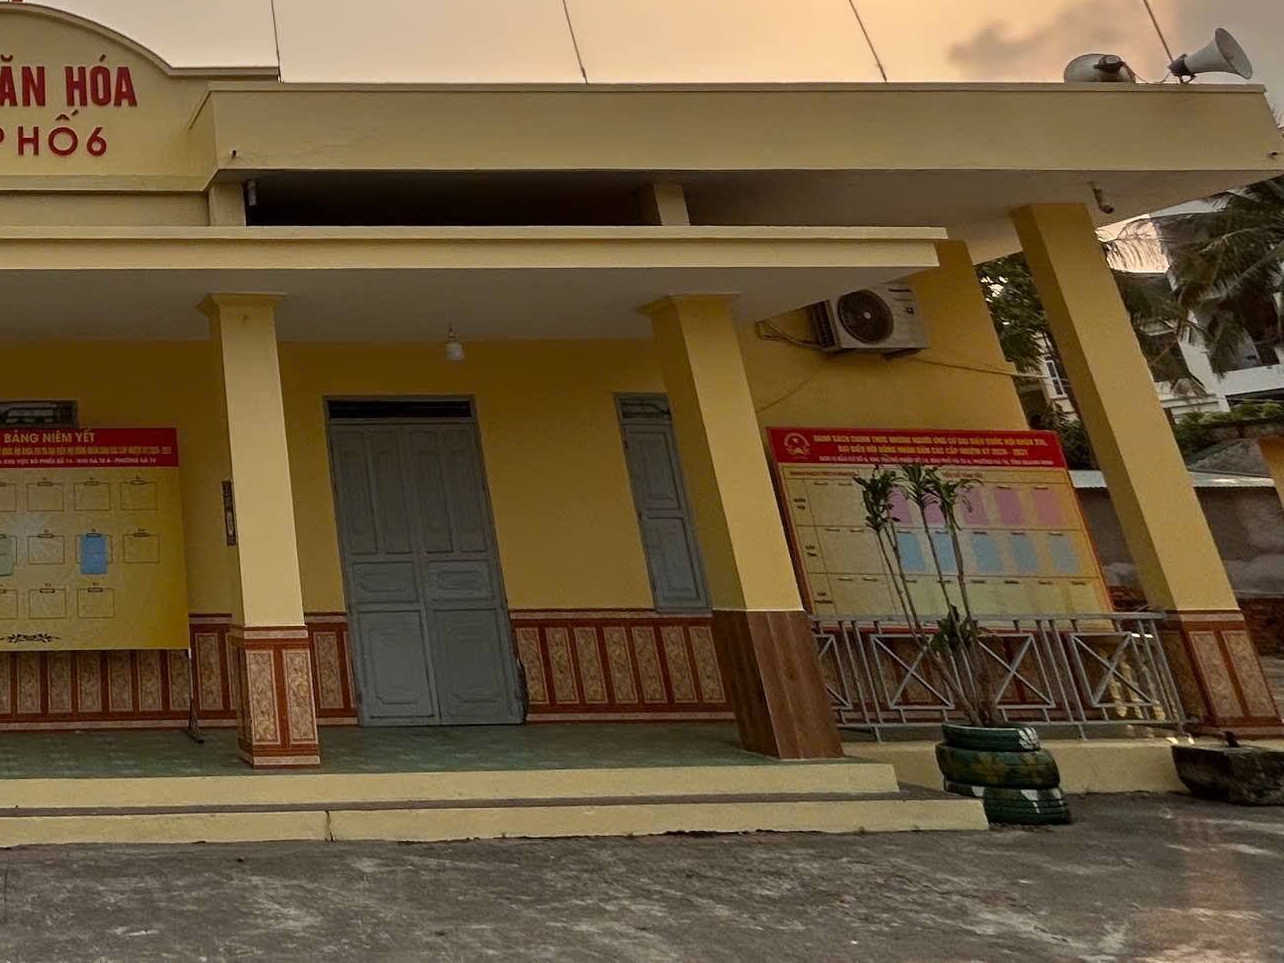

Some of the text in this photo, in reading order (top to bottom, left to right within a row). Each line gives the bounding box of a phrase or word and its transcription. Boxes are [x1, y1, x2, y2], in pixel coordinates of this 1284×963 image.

[65, 54, 138, 107] HÓA
[4, 428, 96, 443] BẢNG NIÊM YẾT
